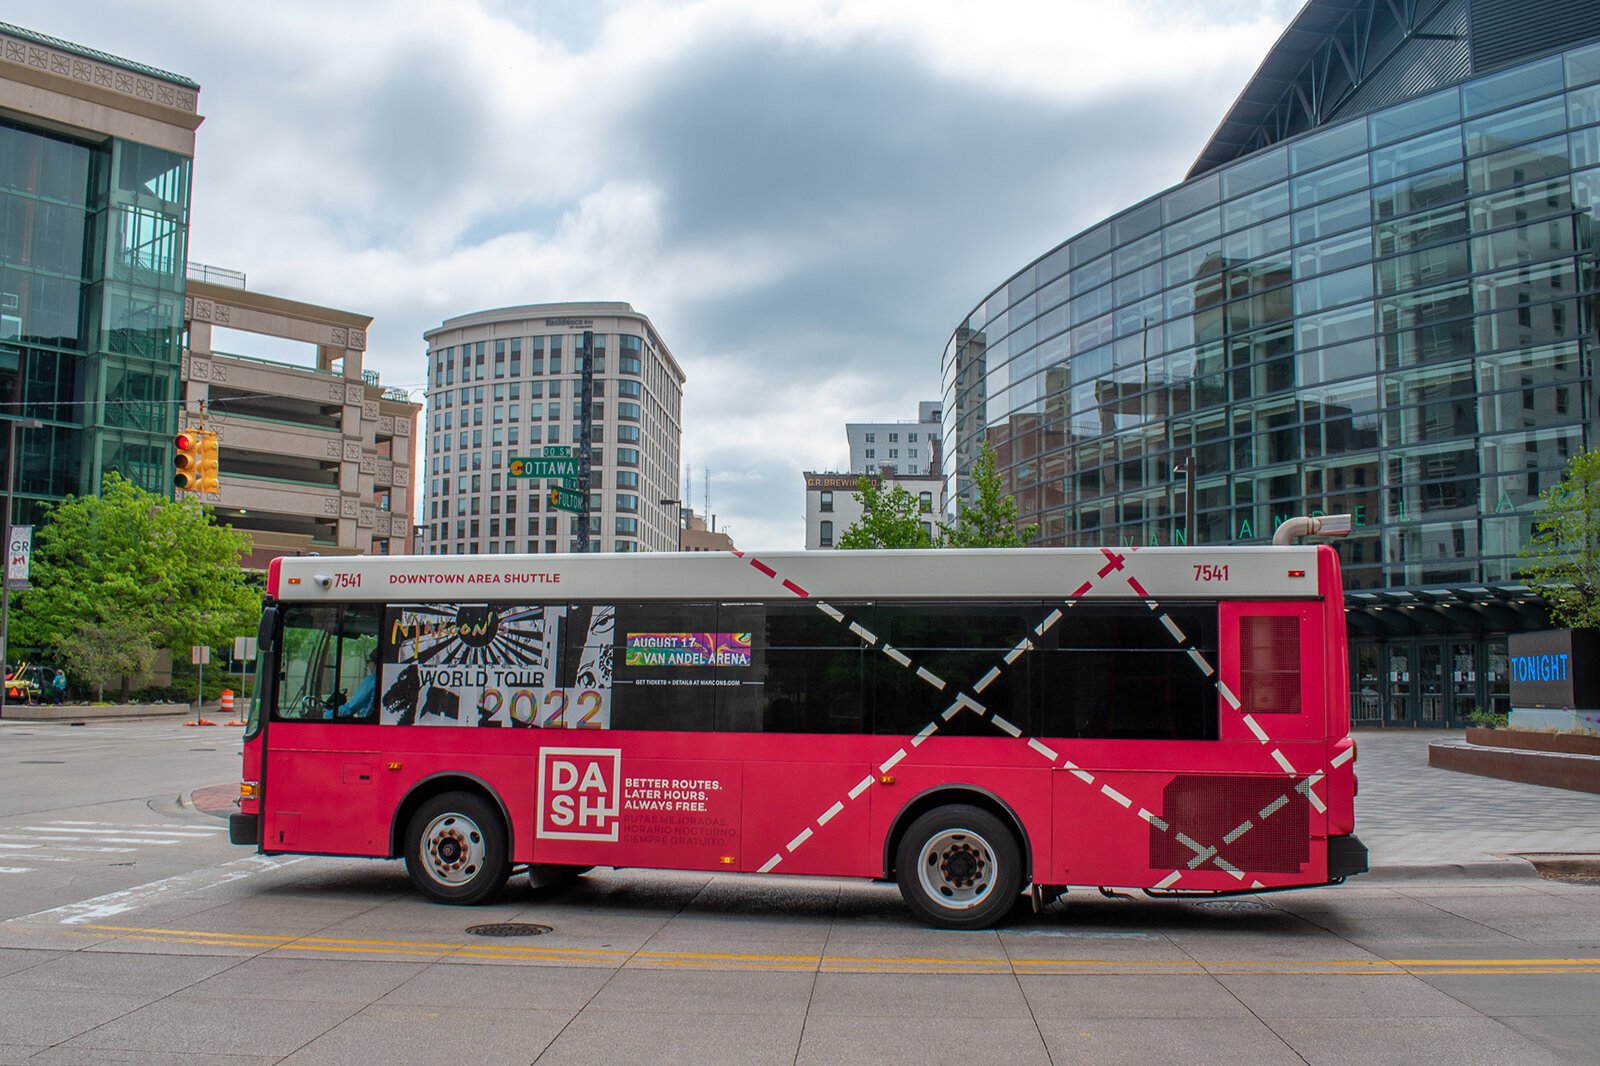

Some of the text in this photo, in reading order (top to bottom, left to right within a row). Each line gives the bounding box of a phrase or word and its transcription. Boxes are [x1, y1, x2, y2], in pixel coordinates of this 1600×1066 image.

[525, 461, 575, 475] OTTAWA
[824, 479, 858, 487] BREWIN
[1123, 527, 1187, 547] VAN
[11, 540, 29, 552] GR
[389, 573, 560, 584] DOWNTOWN AREA SHUTTLE
[1193, 564, 1229, 582] 7541
[334, 573, 362, 588] 7541
[632, 637, 696, 649] AUGUST 17
[643, 652, 748, 666] VAN ANDEL ARENA
[1511, 653, 1569, 683] TONIGHT
[420, 670, 545, 688] WORLD TOUR
[478, 689, 603, 729] 2022
[625, 778, 723, 790] BETTER ROUTES.
[624, 789, 709, 801] LATER HOURS.
[624, 800, 708, 812] ALWAYS FREE.
[623, 825, 673, 834] HORARIO
